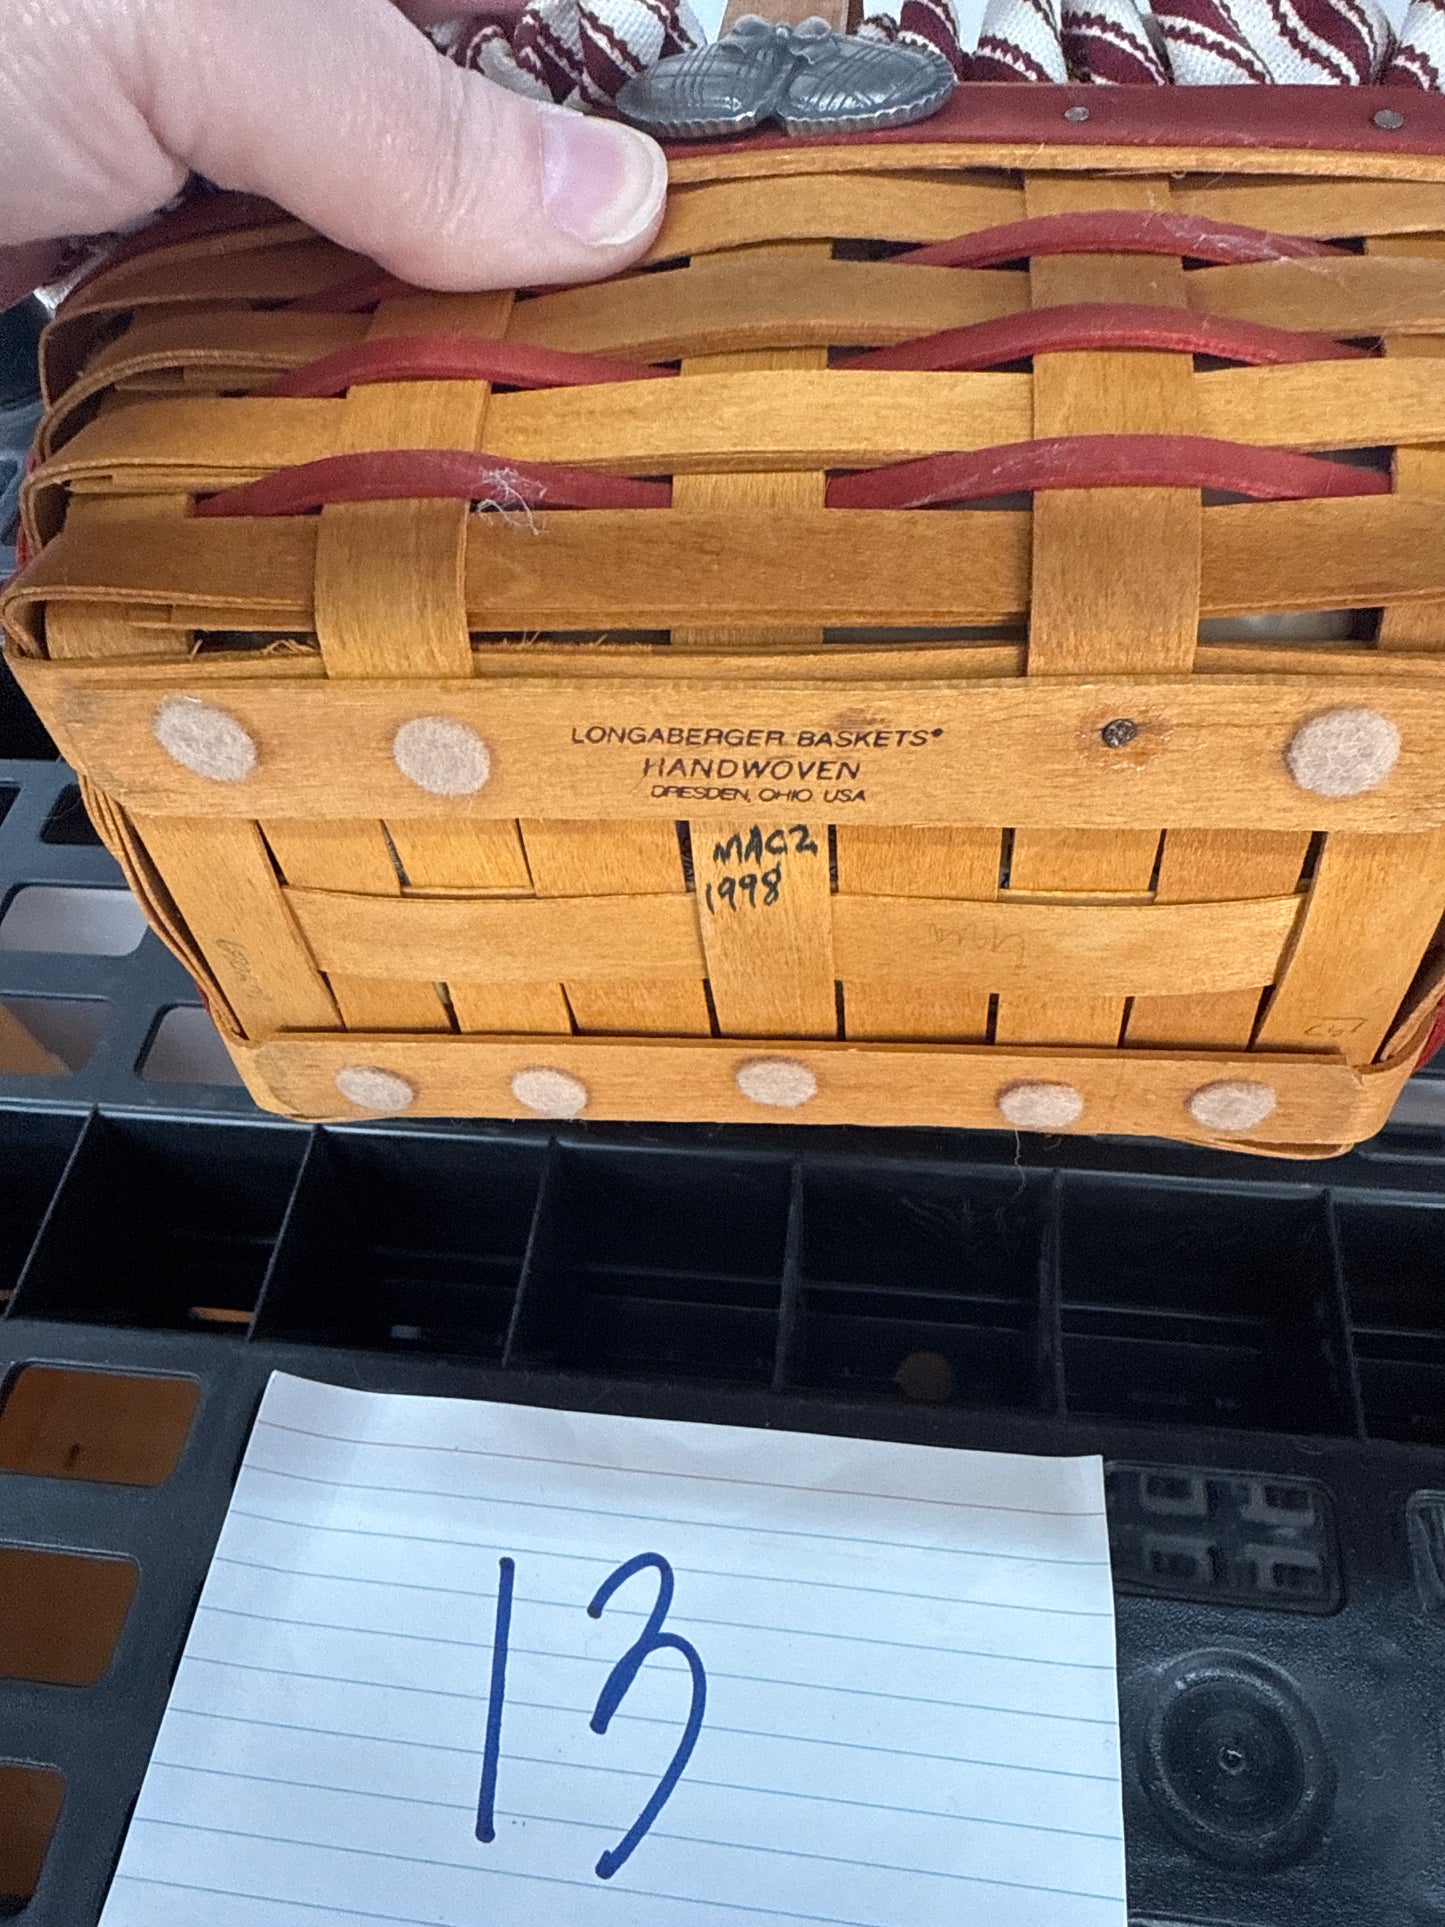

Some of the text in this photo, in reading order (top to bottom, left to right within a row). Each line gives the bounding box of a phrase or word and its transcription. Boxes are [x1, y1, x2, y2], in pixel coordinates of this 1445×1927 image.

[570, 726, 784, 746] LONGABERGER
[643, 757, 861, 781] HANDWOVEN
[650, 784, 867, 803] DRESDEN, OHIO USA
[704, 858, 782, 915] 1998
[475, 1552, 707, 1880] 13
